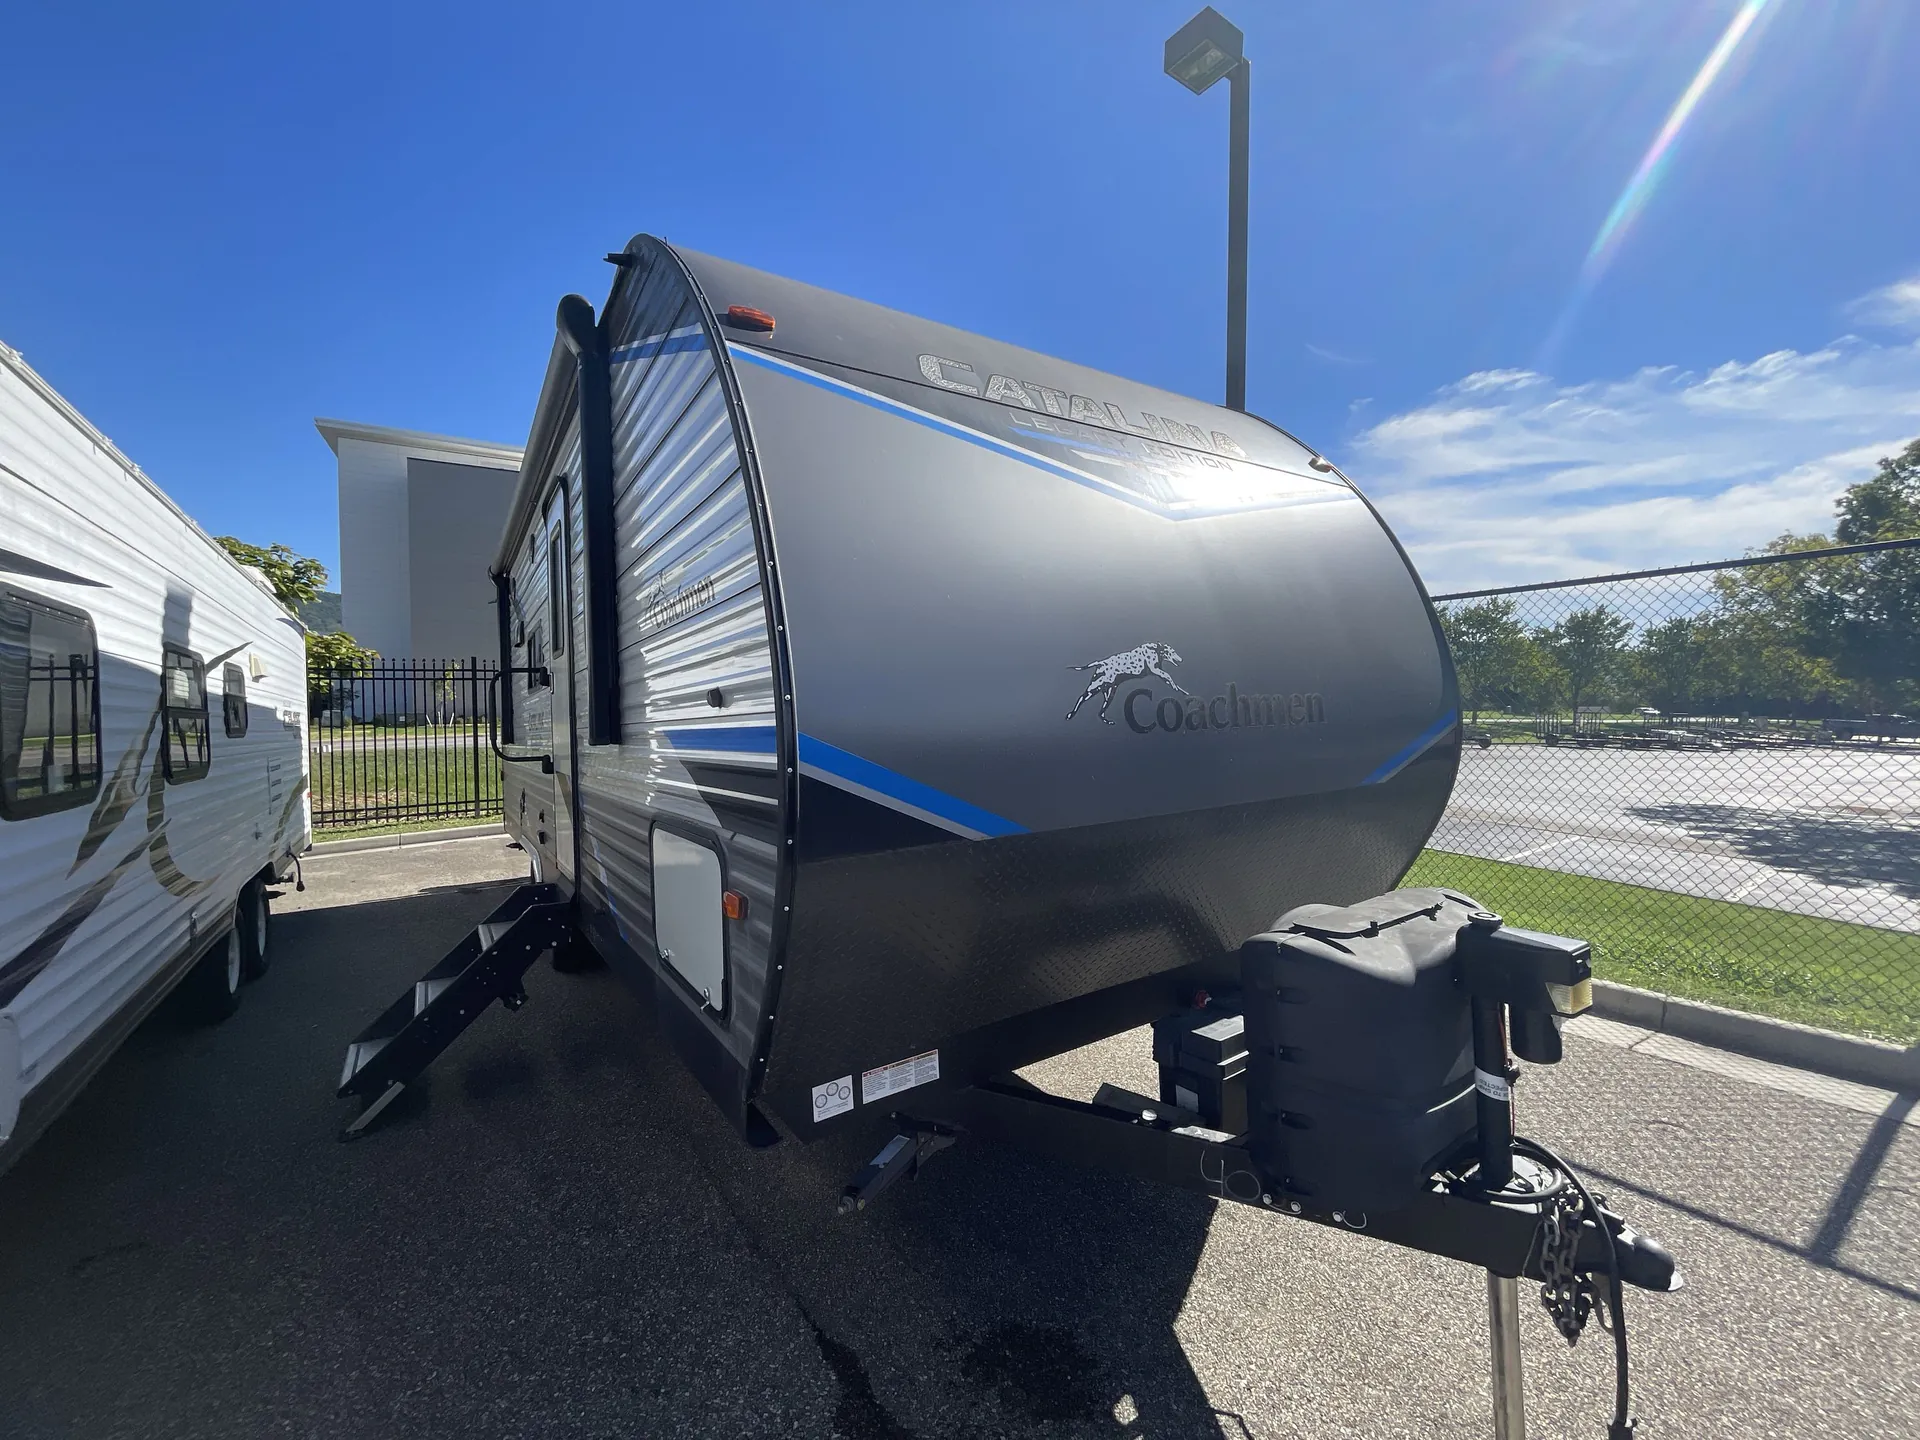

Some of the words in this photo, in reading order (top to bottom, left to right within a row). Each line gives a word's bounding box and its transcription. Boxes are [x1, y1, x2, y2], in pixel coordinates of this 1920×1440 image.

[918, 353, 1249, 459] CATALINA
[1009, 411, 1127, 448] LEGACY
[1142, 442, 1235, 472] EDITION
[1124, 681, 1327, 734] Coachmen
